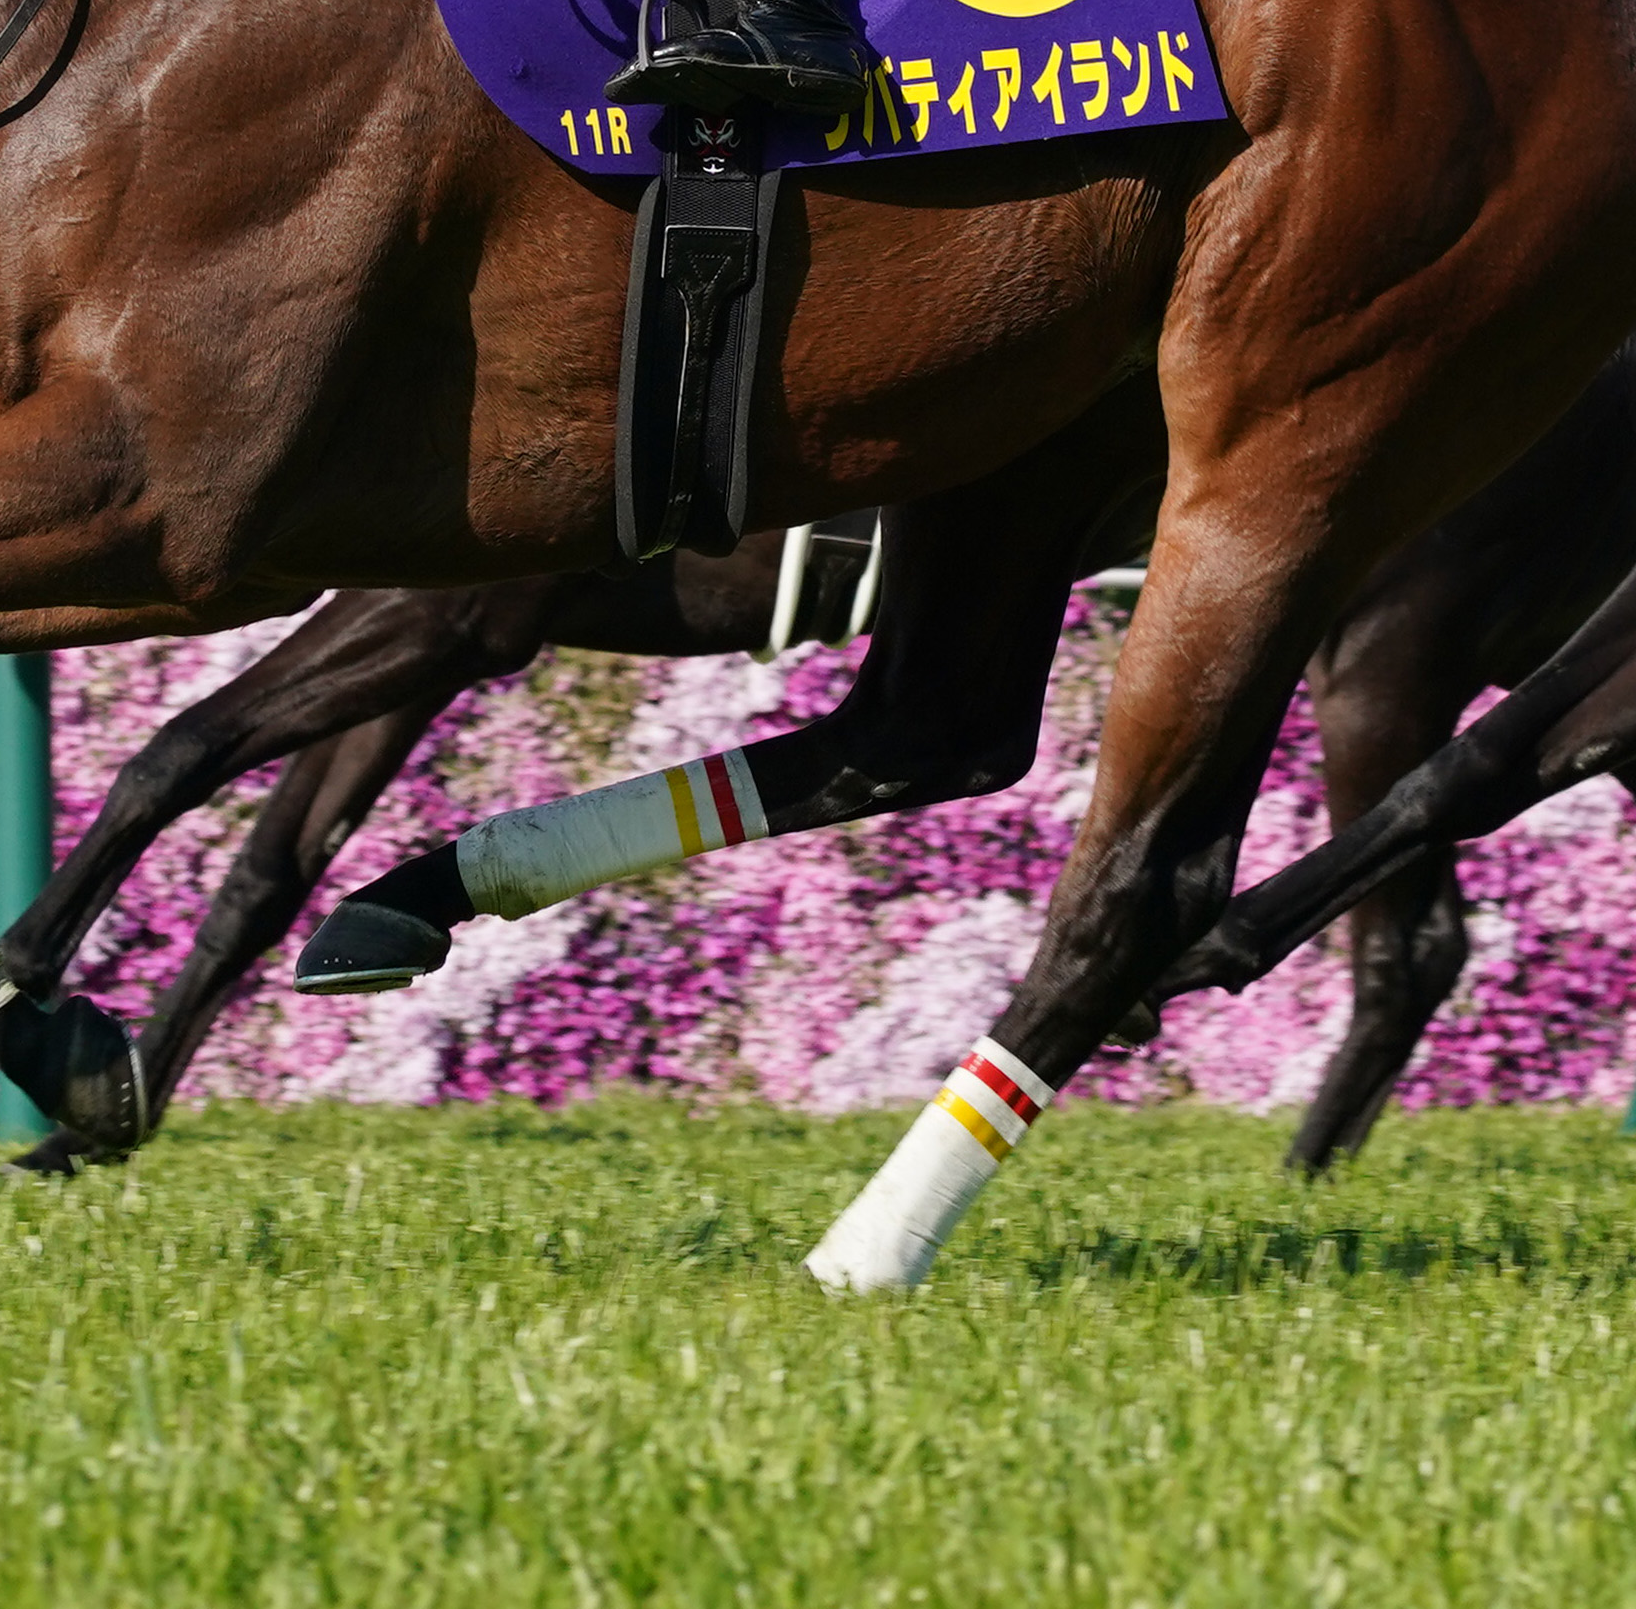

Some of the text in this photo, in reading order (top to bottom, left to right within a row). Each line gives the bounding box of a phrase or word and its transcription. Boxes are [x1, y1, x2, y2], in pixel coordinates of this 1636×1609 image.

[560, 106, 632, 155] 11R
[825, 31, 1195, 151] バティアイランド
